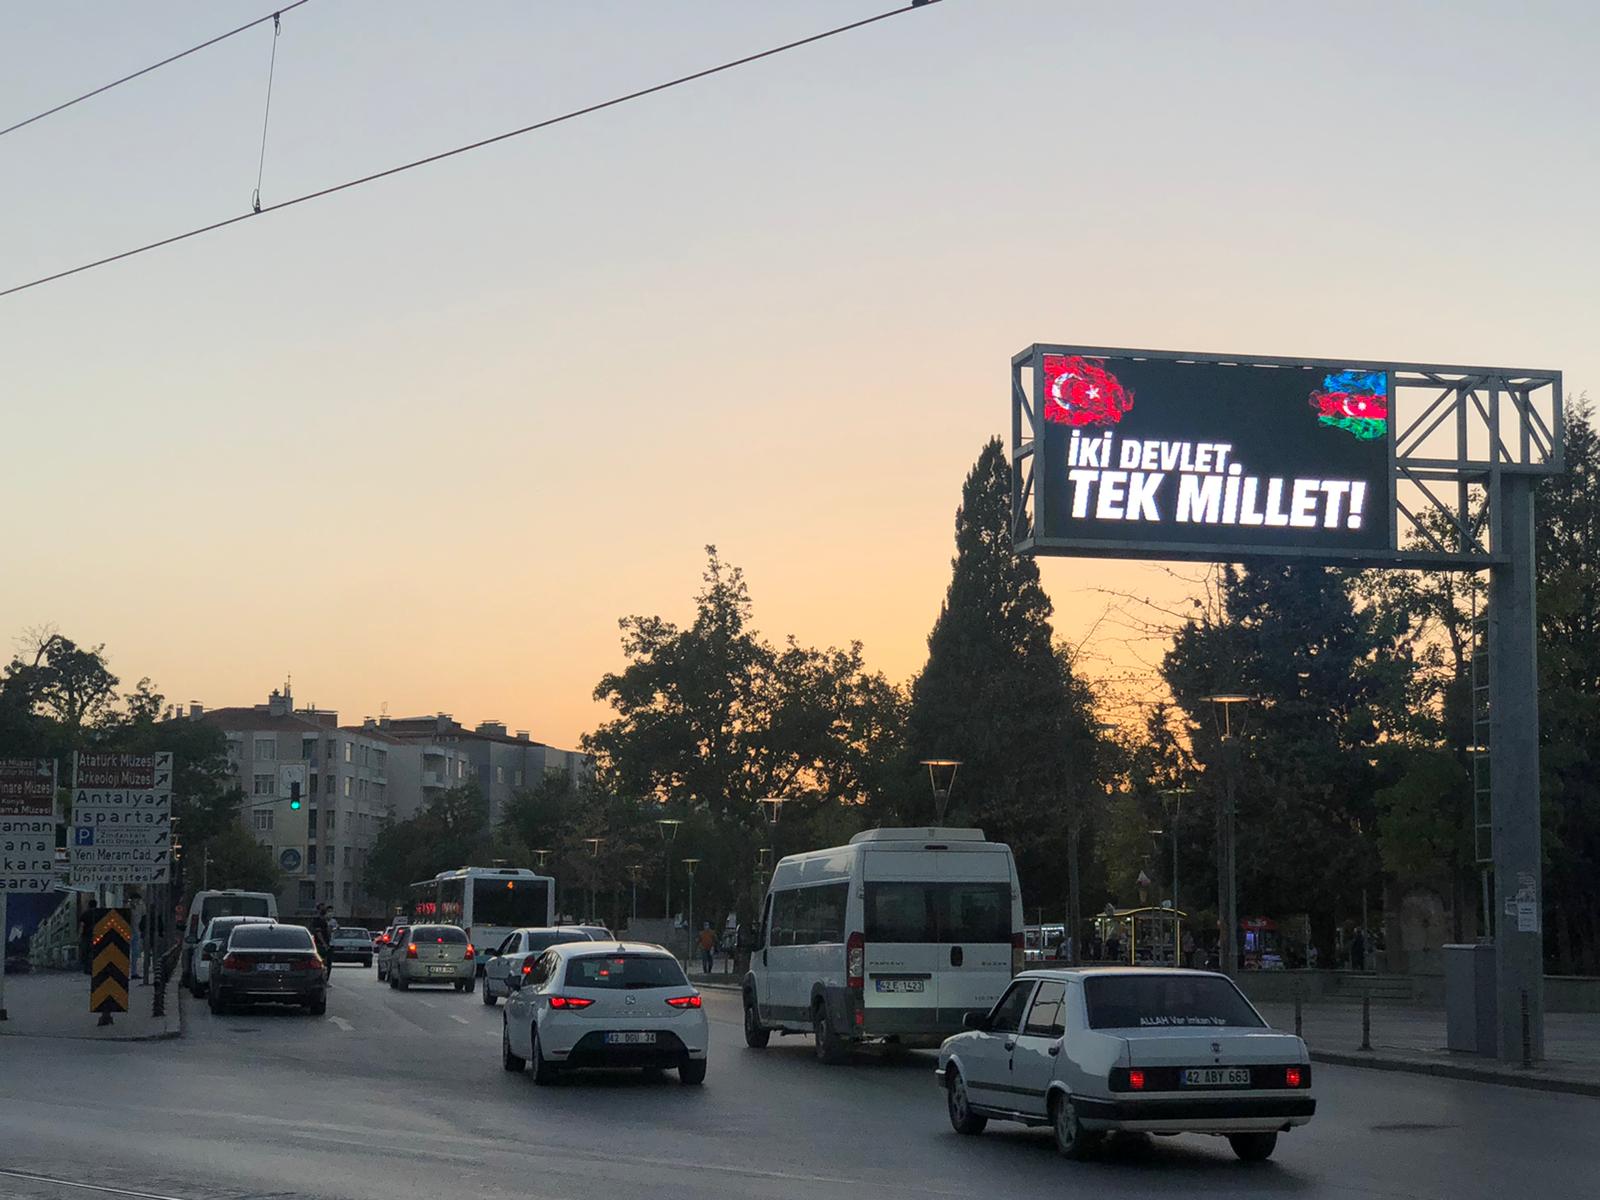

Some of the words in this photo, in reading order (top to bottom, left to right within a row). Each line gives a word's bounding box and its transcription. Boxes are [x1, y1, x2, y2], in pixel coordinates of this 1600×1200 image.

[1068, 429, 1113, 468] İKİ
[1068, 469, 1165, 521] TEK
[1176, 463, 1366, 529] MİLLET!
[79, 753, 117, 768] Atatürk
[120, 754, 155, 768] Müzesi
[78, 771, 119, 787] Arkeoloji
[121, 771, 154, 785] Müzesi
[76, 790, 155, 808] Antalya
[75, 809, 154, 826] Isparta
[75, 849, 95, 860] Yeni
[97, 848, 131, 860] Meram
[507, 881, 514, 890] 4
[1140, 1016, 1169, 1025] ALLAH
[1186, 1071, 1200, 1083] 42
[1205, 1071, 1224, 1083] ABY
[1228, 1070, 1249, 1082] 663
